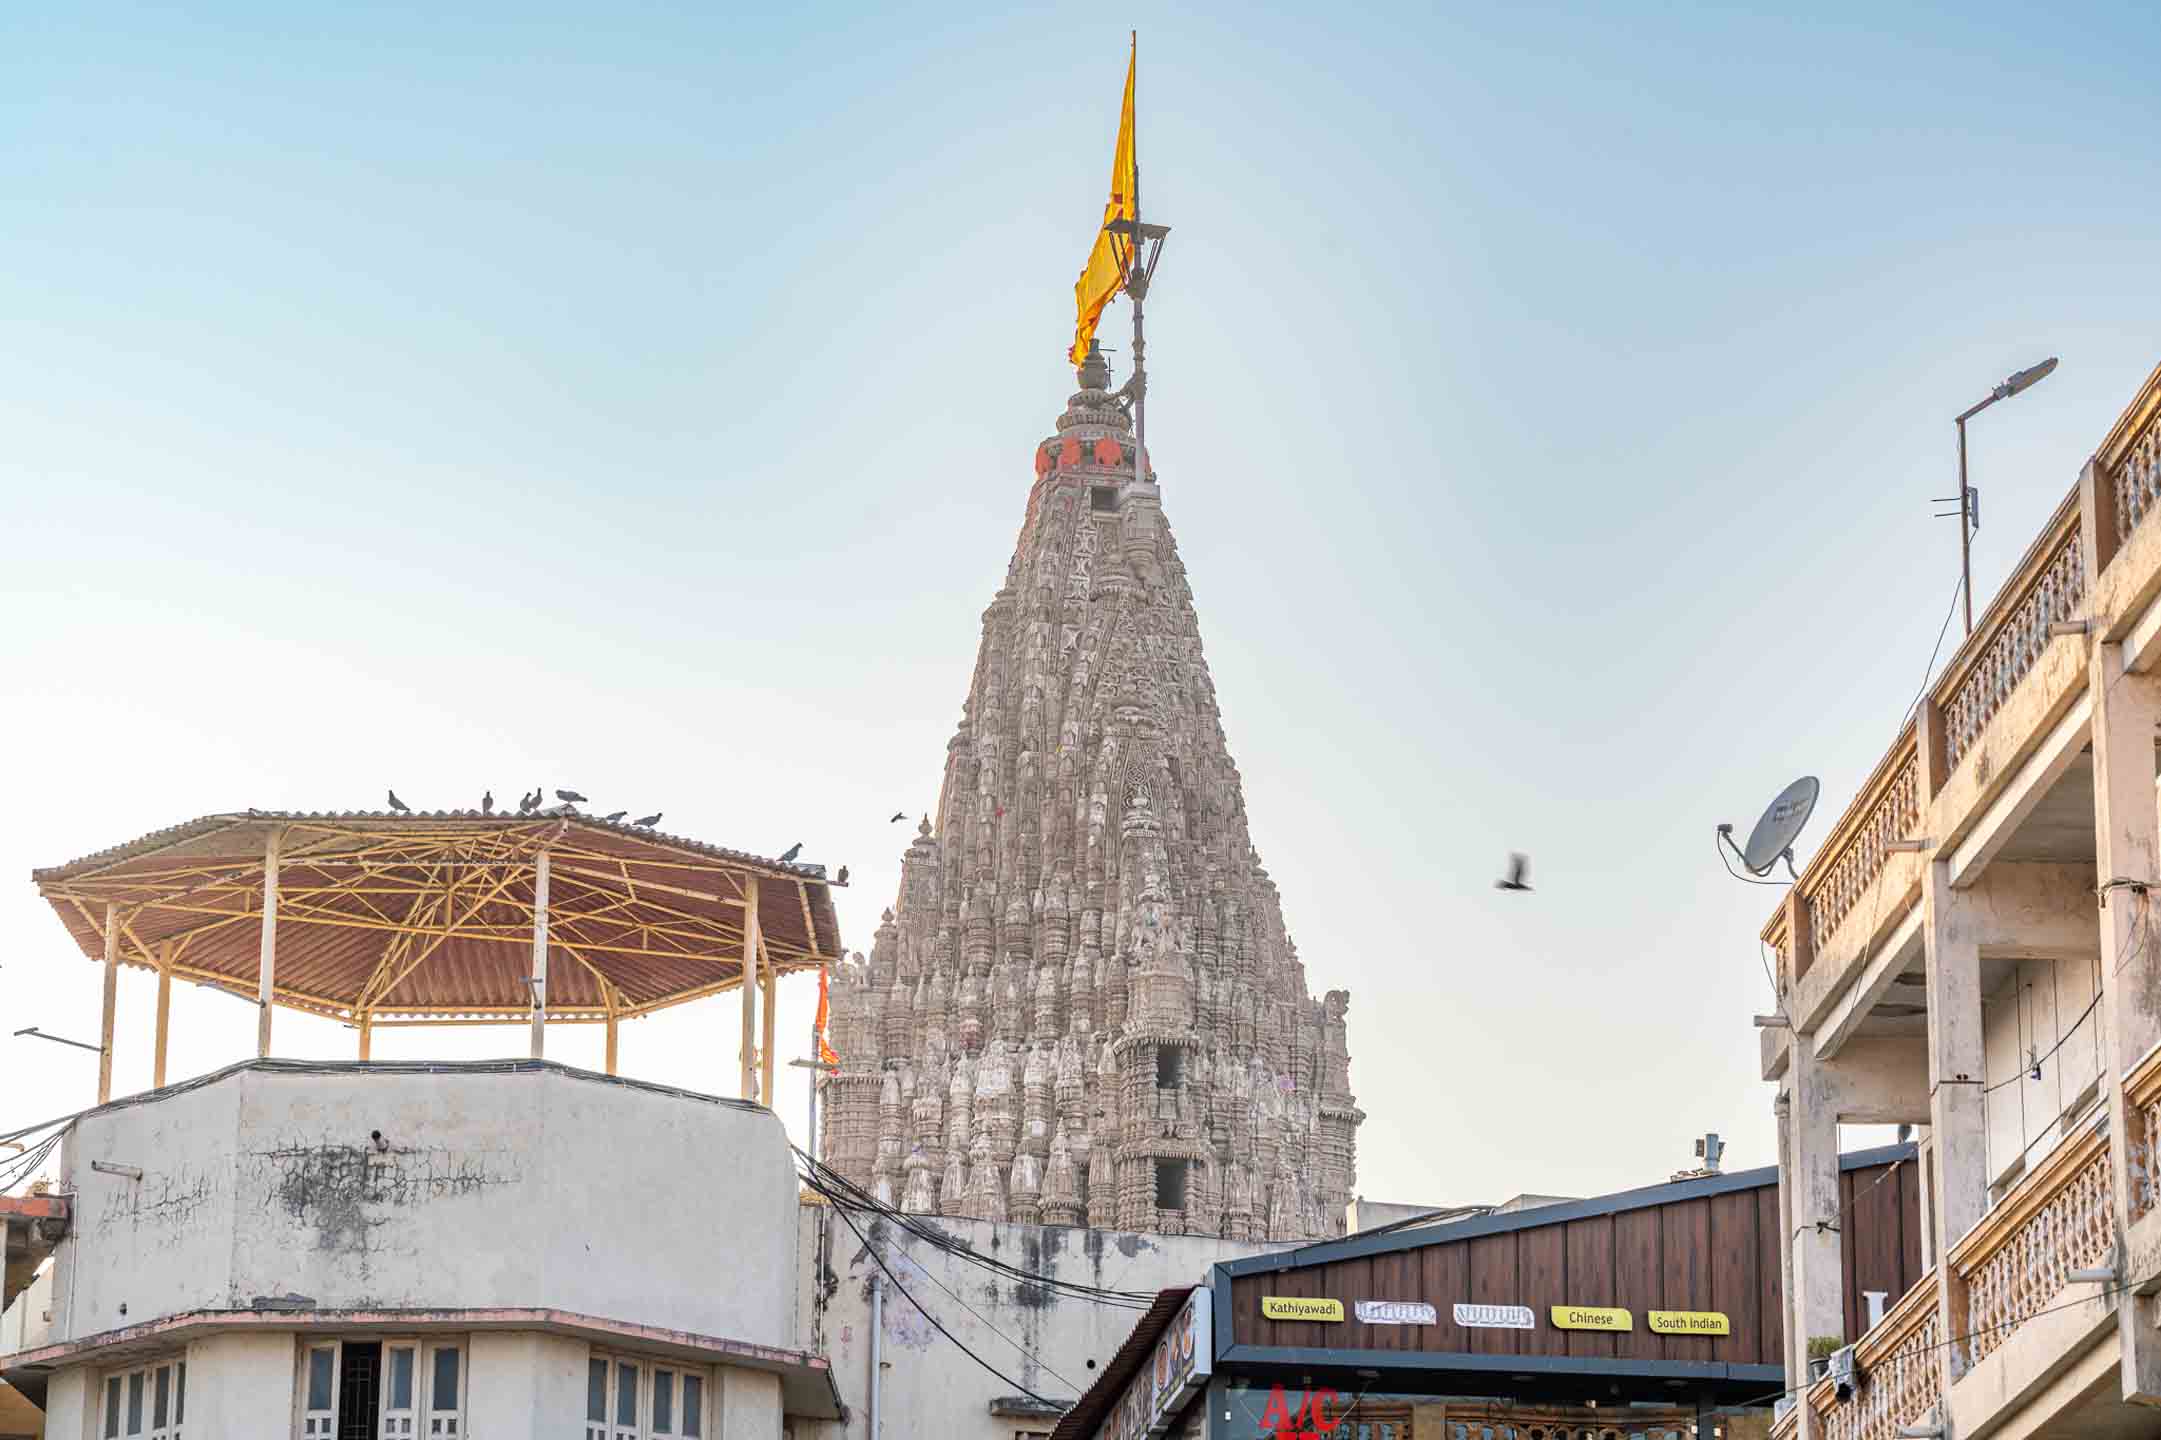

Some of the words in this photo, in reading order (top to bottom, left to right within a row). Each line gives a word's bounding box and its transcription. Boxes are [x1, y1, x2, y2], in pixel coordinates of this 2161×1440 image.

[1270, 1302, 1336, 1316] Kathiyawadi
[1569, 1310, 1614, 1326] Chinese
[1657, 1316, 1687, 1329] South
[1690, 1317, 1722, 1330] Indian
[1258, 1382, 1341, 1431] A/C
